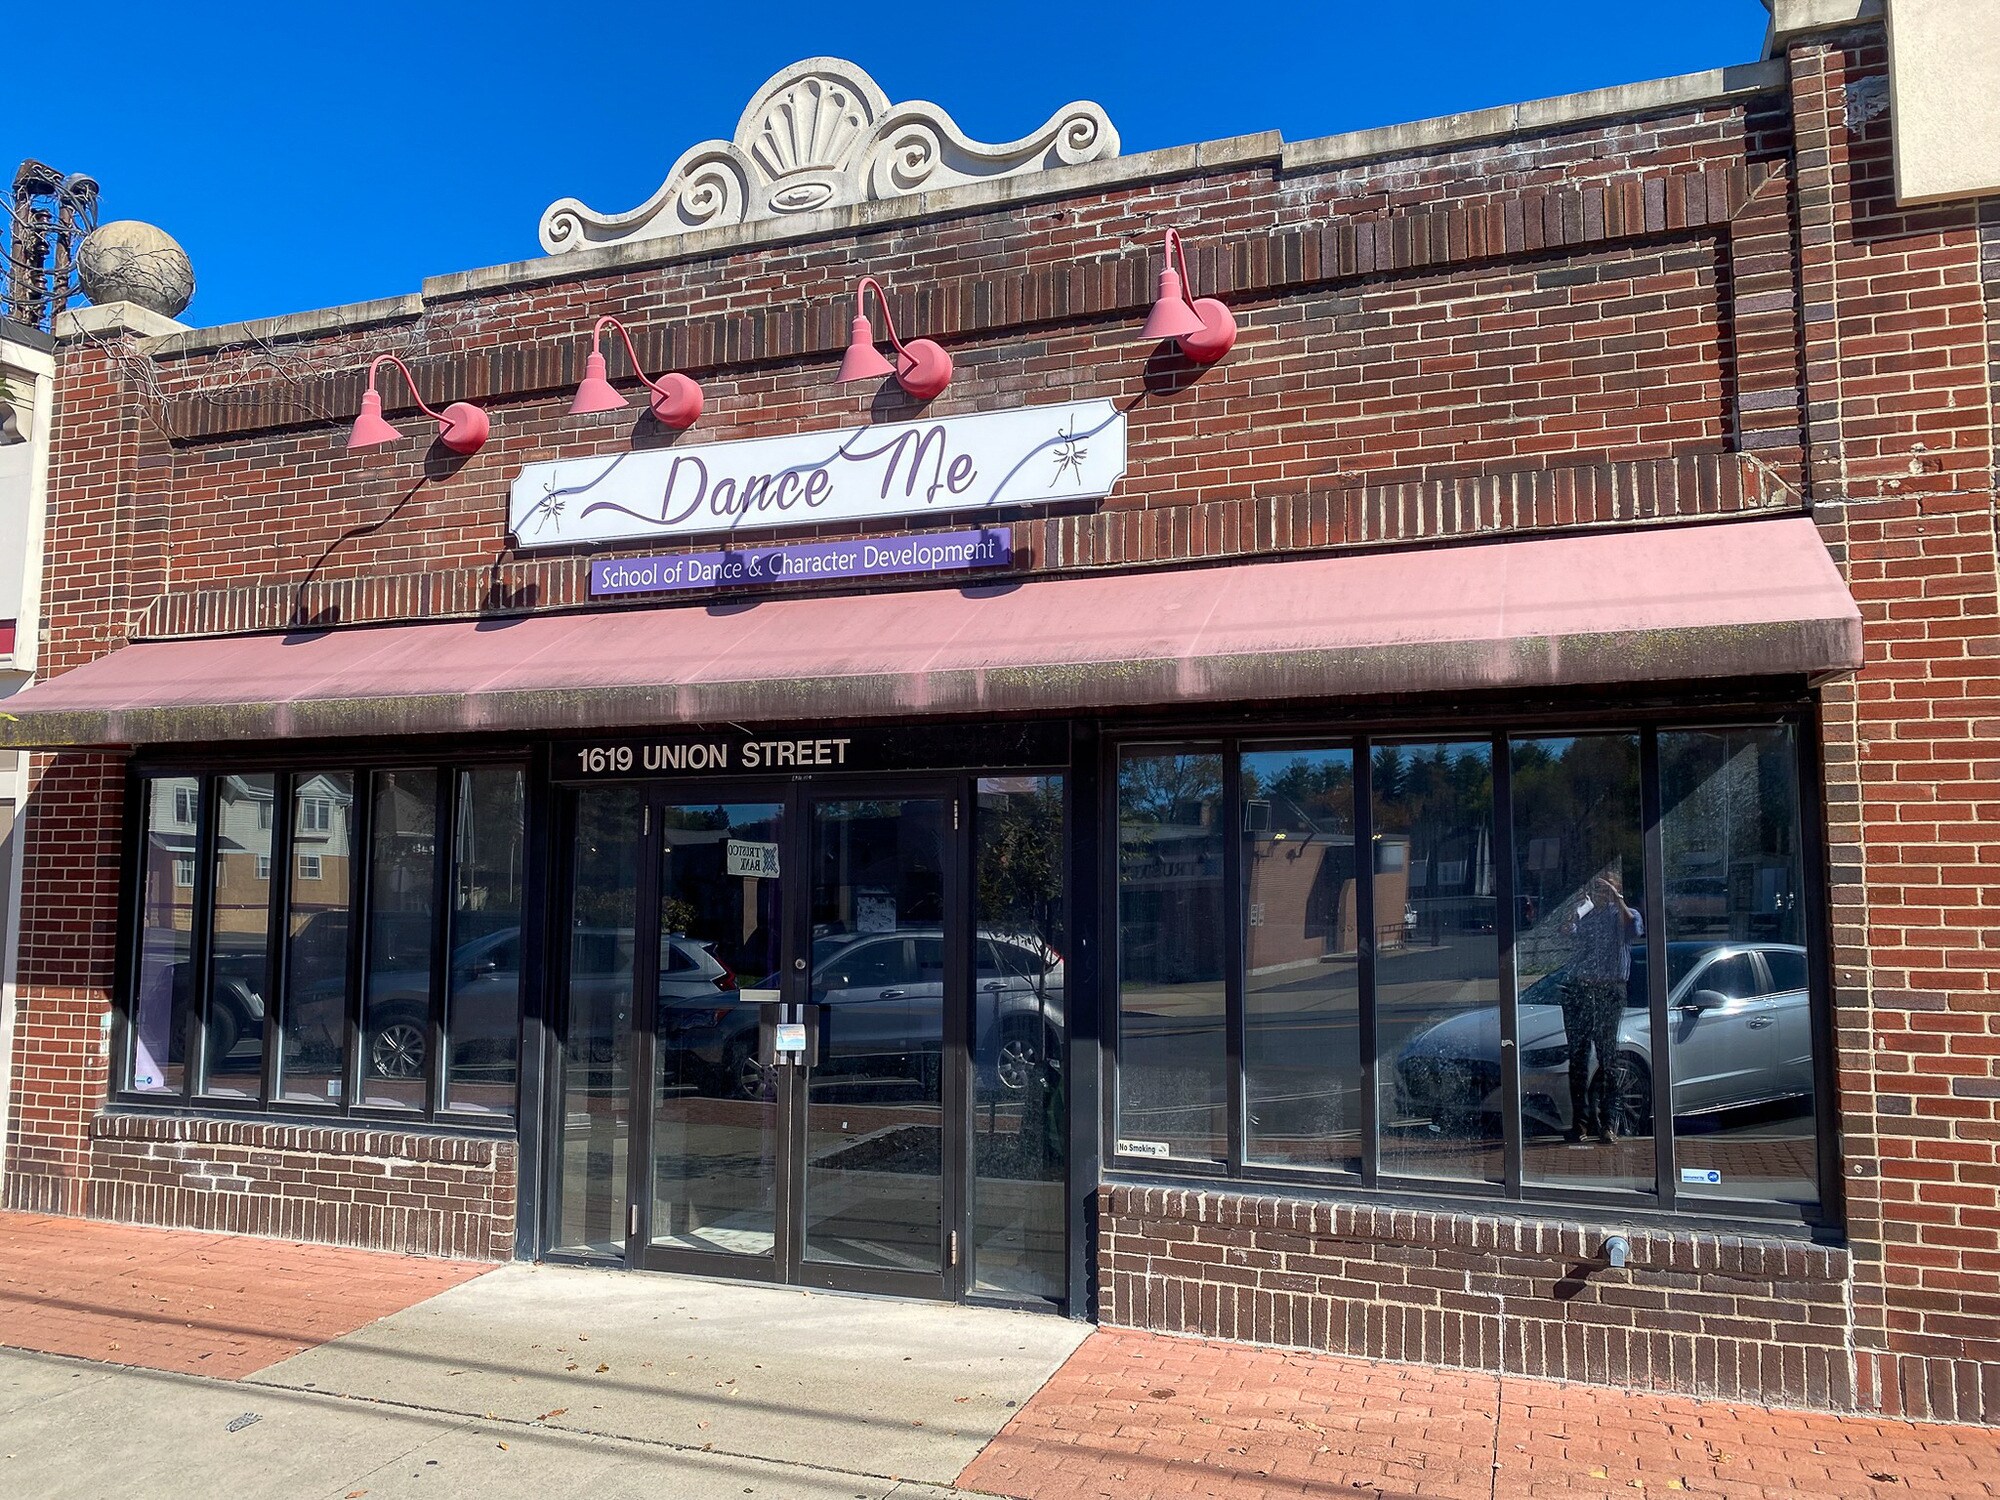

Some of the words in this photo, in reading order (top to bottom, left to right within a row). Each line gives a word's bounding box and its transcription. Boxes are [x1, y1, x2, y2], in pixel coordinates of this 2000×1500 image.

[580, 456, 834, 525] Dance
[838, 424, 978, 504] Me
[602, 562, 657, 589] School
[663, 560, 682, 584] of
[688, 559, 742, 582] Dance
[748, 555, 763, 577] &
[769, 551, 857, 575] Character
[864, 538, 995, 569] Development
[578, 746, 633, 772] 1619
[643, 744, 727, 770] UNION
[741, 738, 851, 767] STREET
[1119, 1143, 1128, 1151] No
[1129, 1143, 1156, 1155] Smoking
